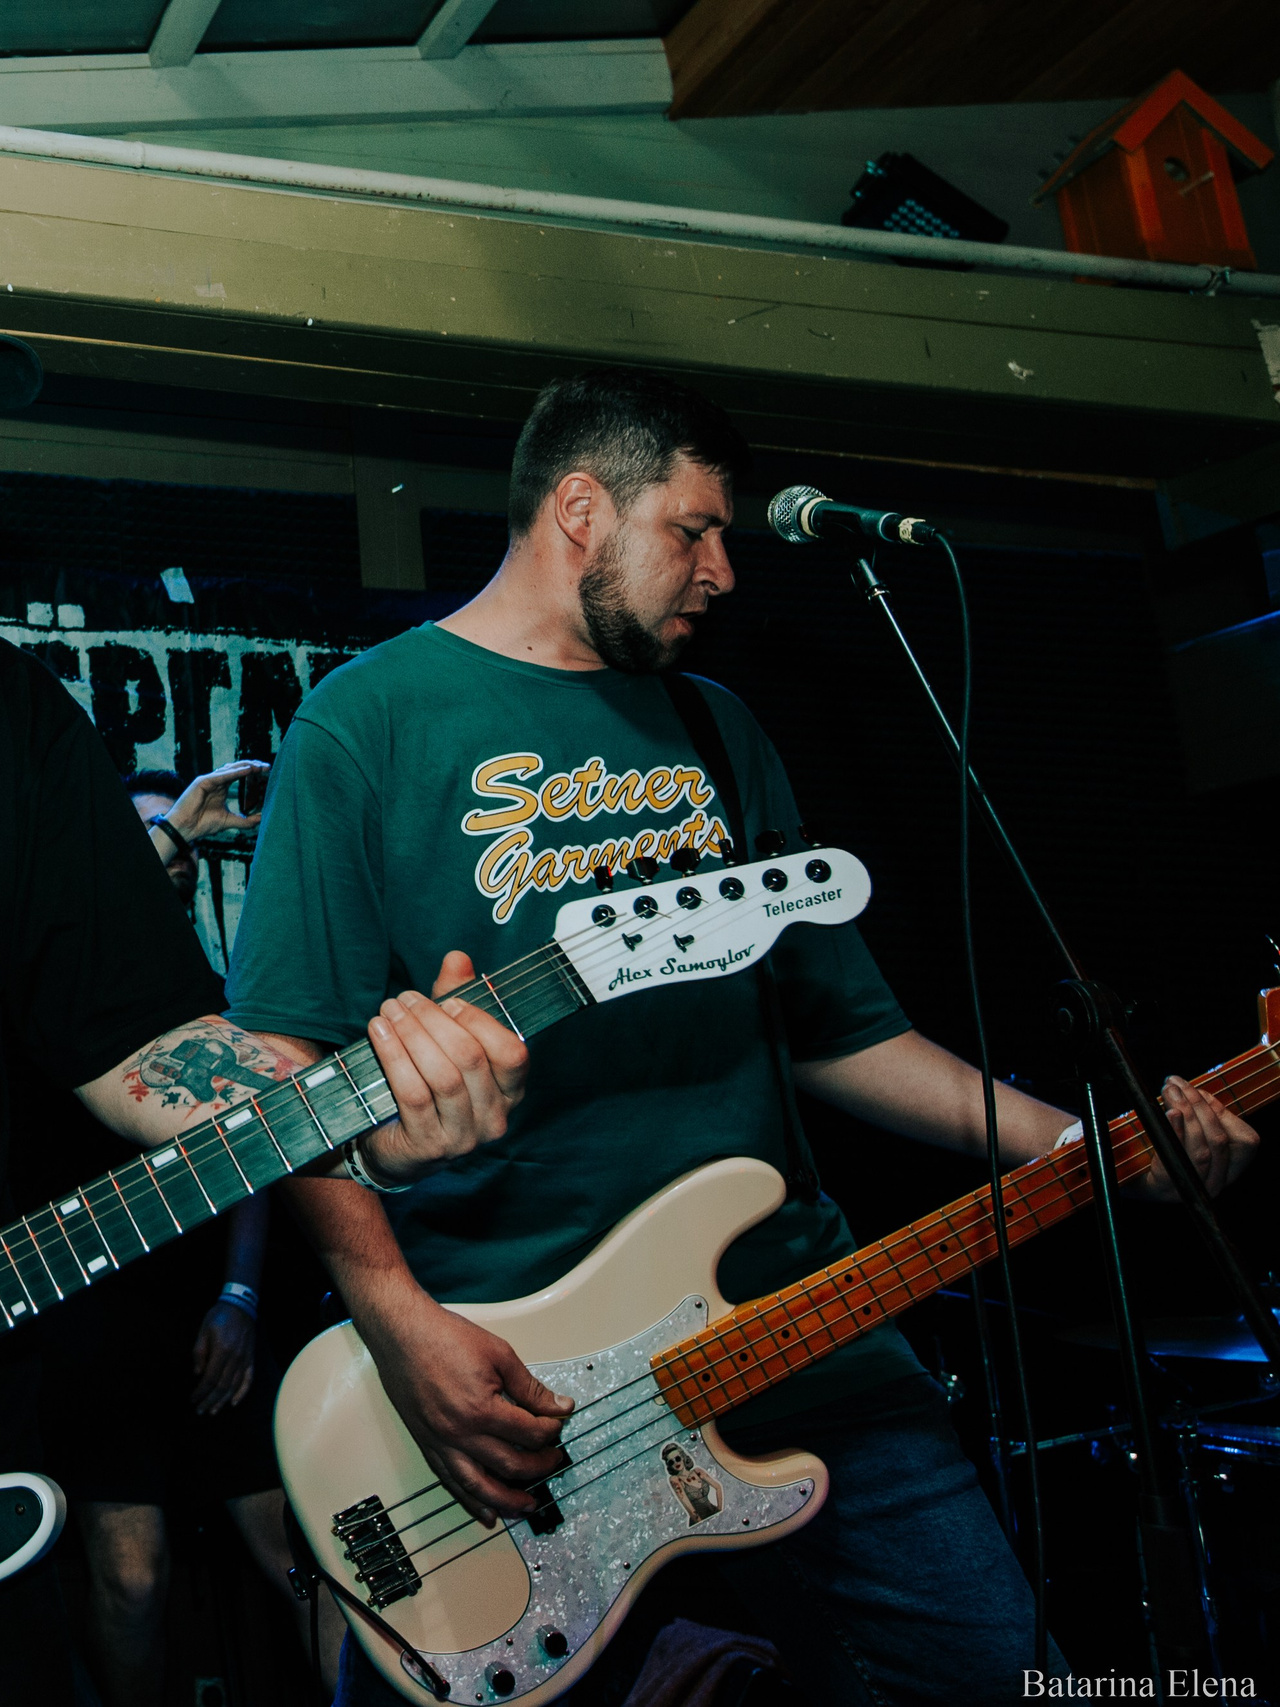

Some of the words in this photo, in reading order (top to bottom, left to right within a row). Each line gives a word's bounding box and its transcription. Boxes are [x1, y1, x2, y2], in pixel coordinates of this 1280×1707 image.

[462, 753, 715, 834] Setner
[475, 810, 732, 925] Garments
[763, 888, 843, 918] Telecaster
[608, 967, 653, 991] Alex
[660, 944, 756, 976] Samoylov
